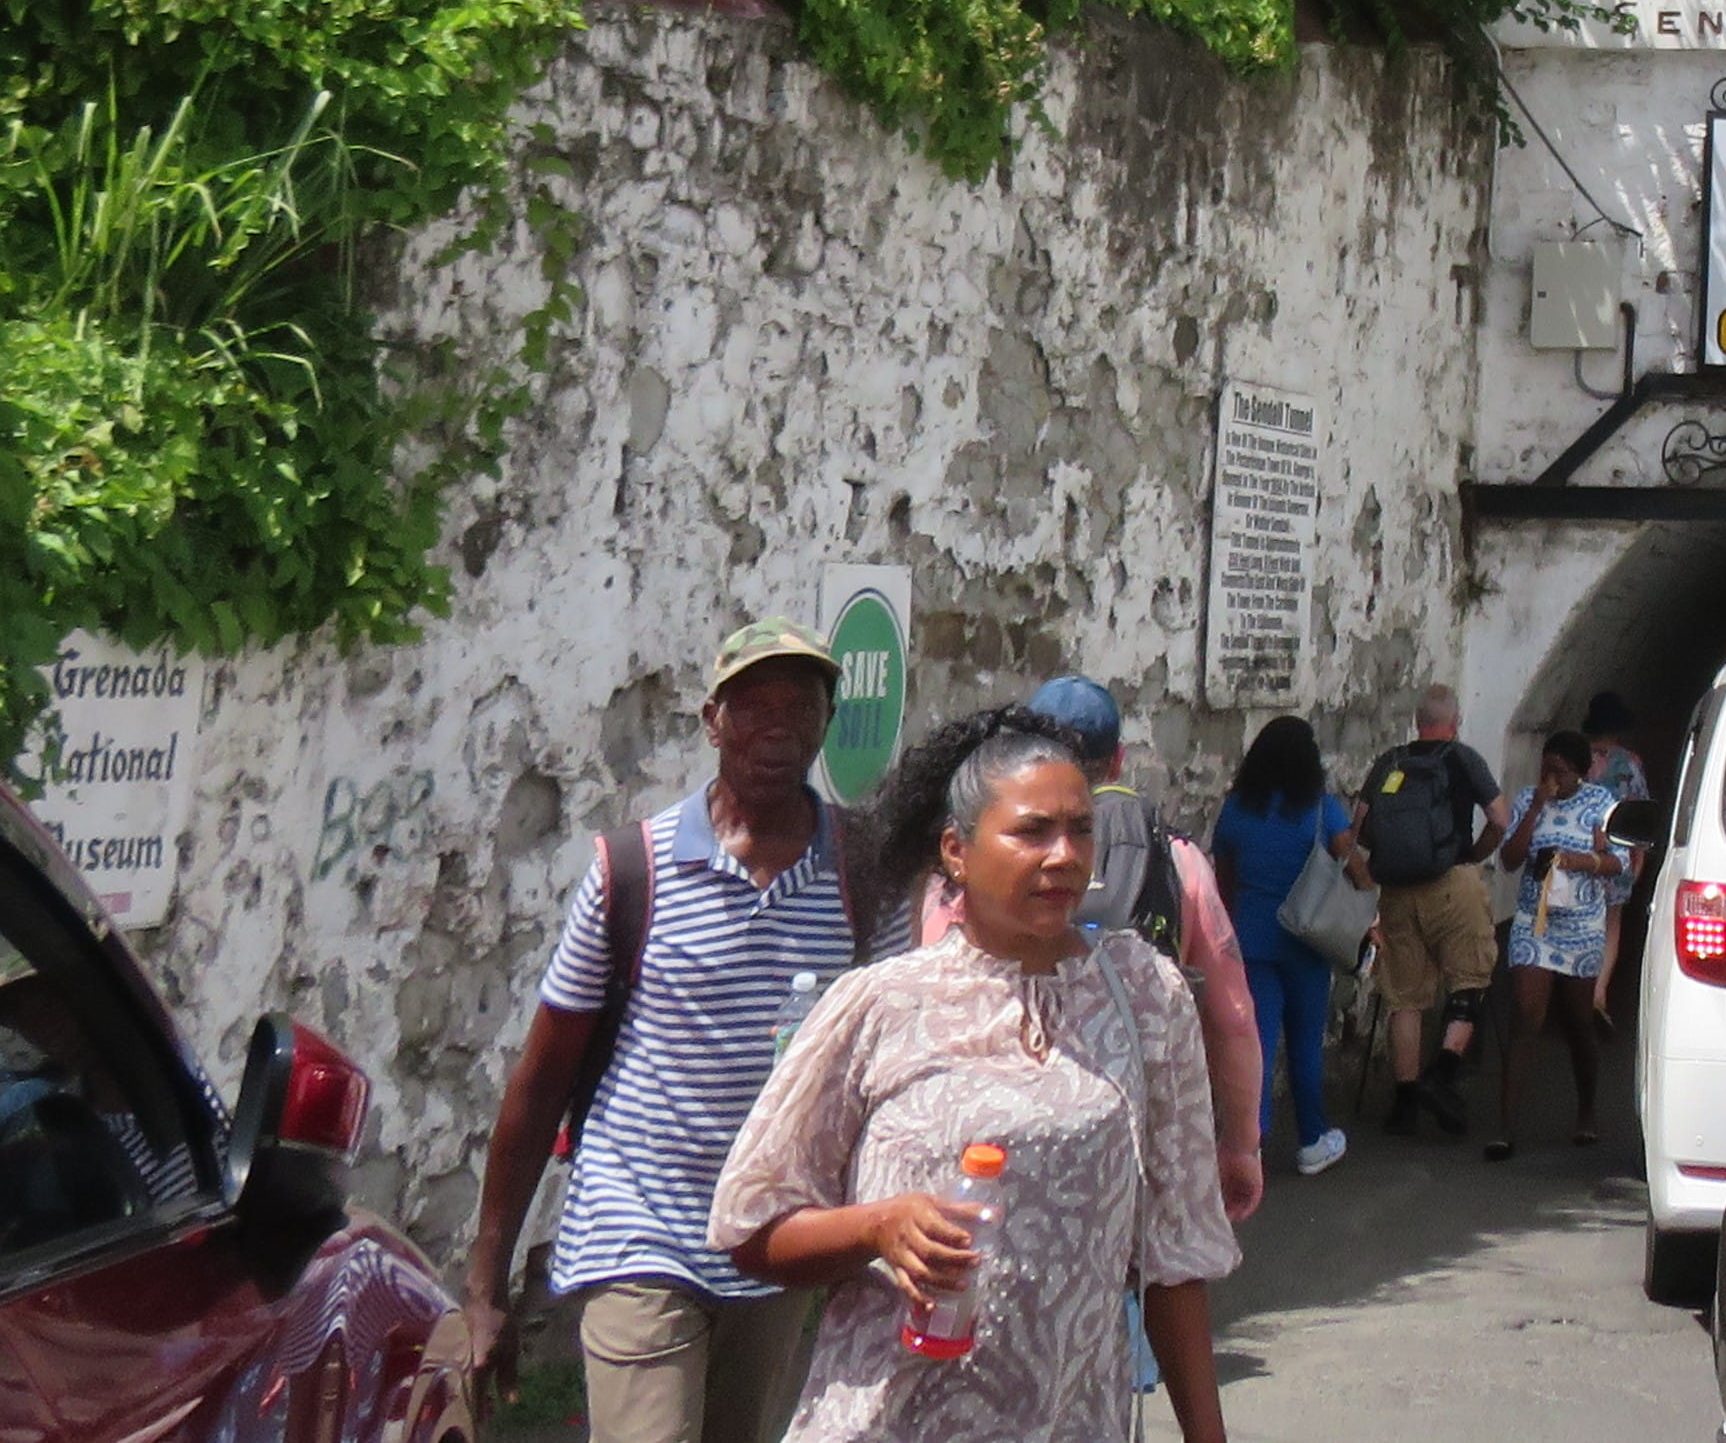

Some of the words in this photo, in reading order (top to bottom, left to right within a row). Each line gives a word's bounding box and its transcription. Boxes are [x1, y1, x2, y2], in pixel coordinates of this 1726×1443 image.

[1234, 391, 1250, 421] The
[1251, 394, 1284, 428] Sendall
[1285, 402, 1313, 433] Tunnel
[54, 648, 187, 699] Grenada
[840, 650, 890, 701] SAVE
[50, 728, 179, 783] ational
